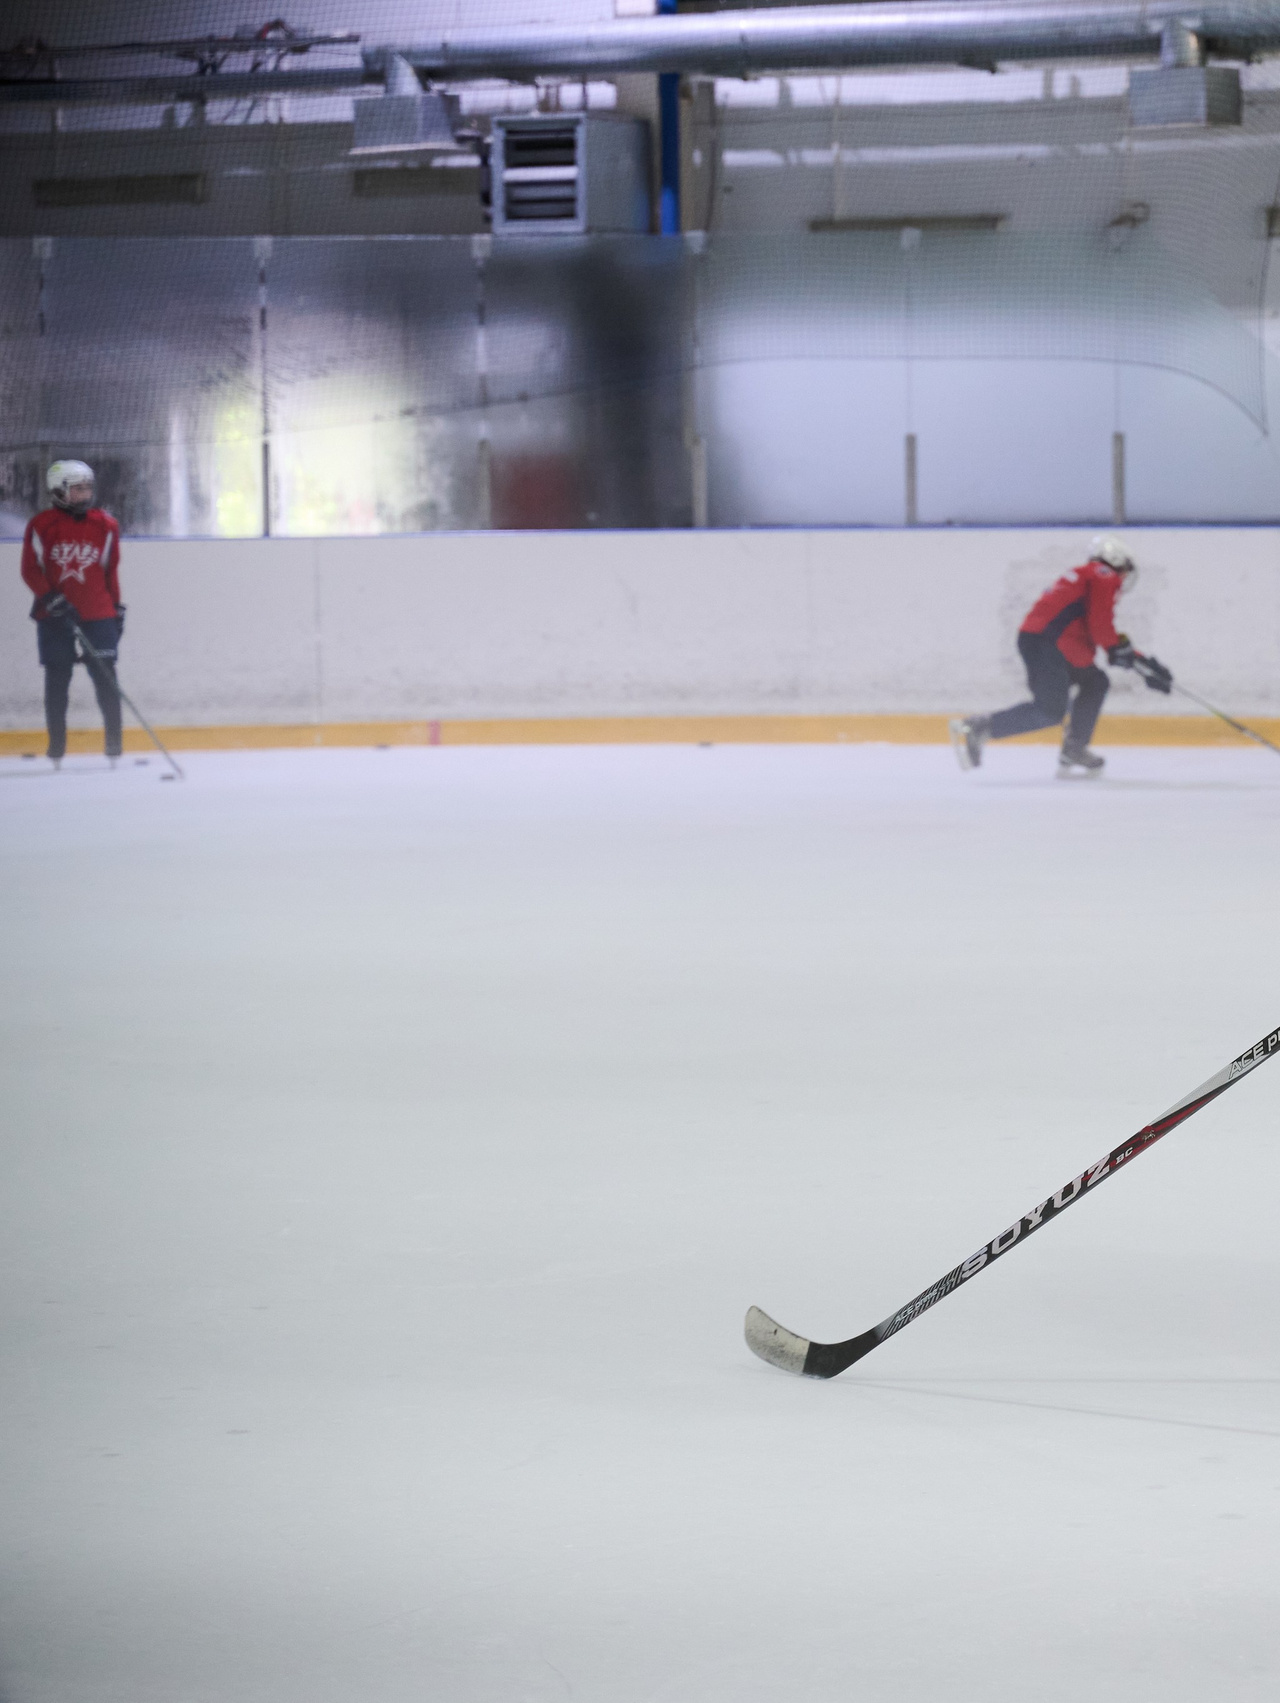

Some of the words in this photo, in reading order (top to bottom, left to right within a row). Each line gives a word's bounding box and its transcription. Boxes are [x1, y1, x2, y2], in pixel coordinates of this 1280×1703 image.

[1228, 1040, 1265, 1080] ACE
[961, 1153, 1111, 1279] SOYUZ
[1115, 1146, 1133, 1165] BC
